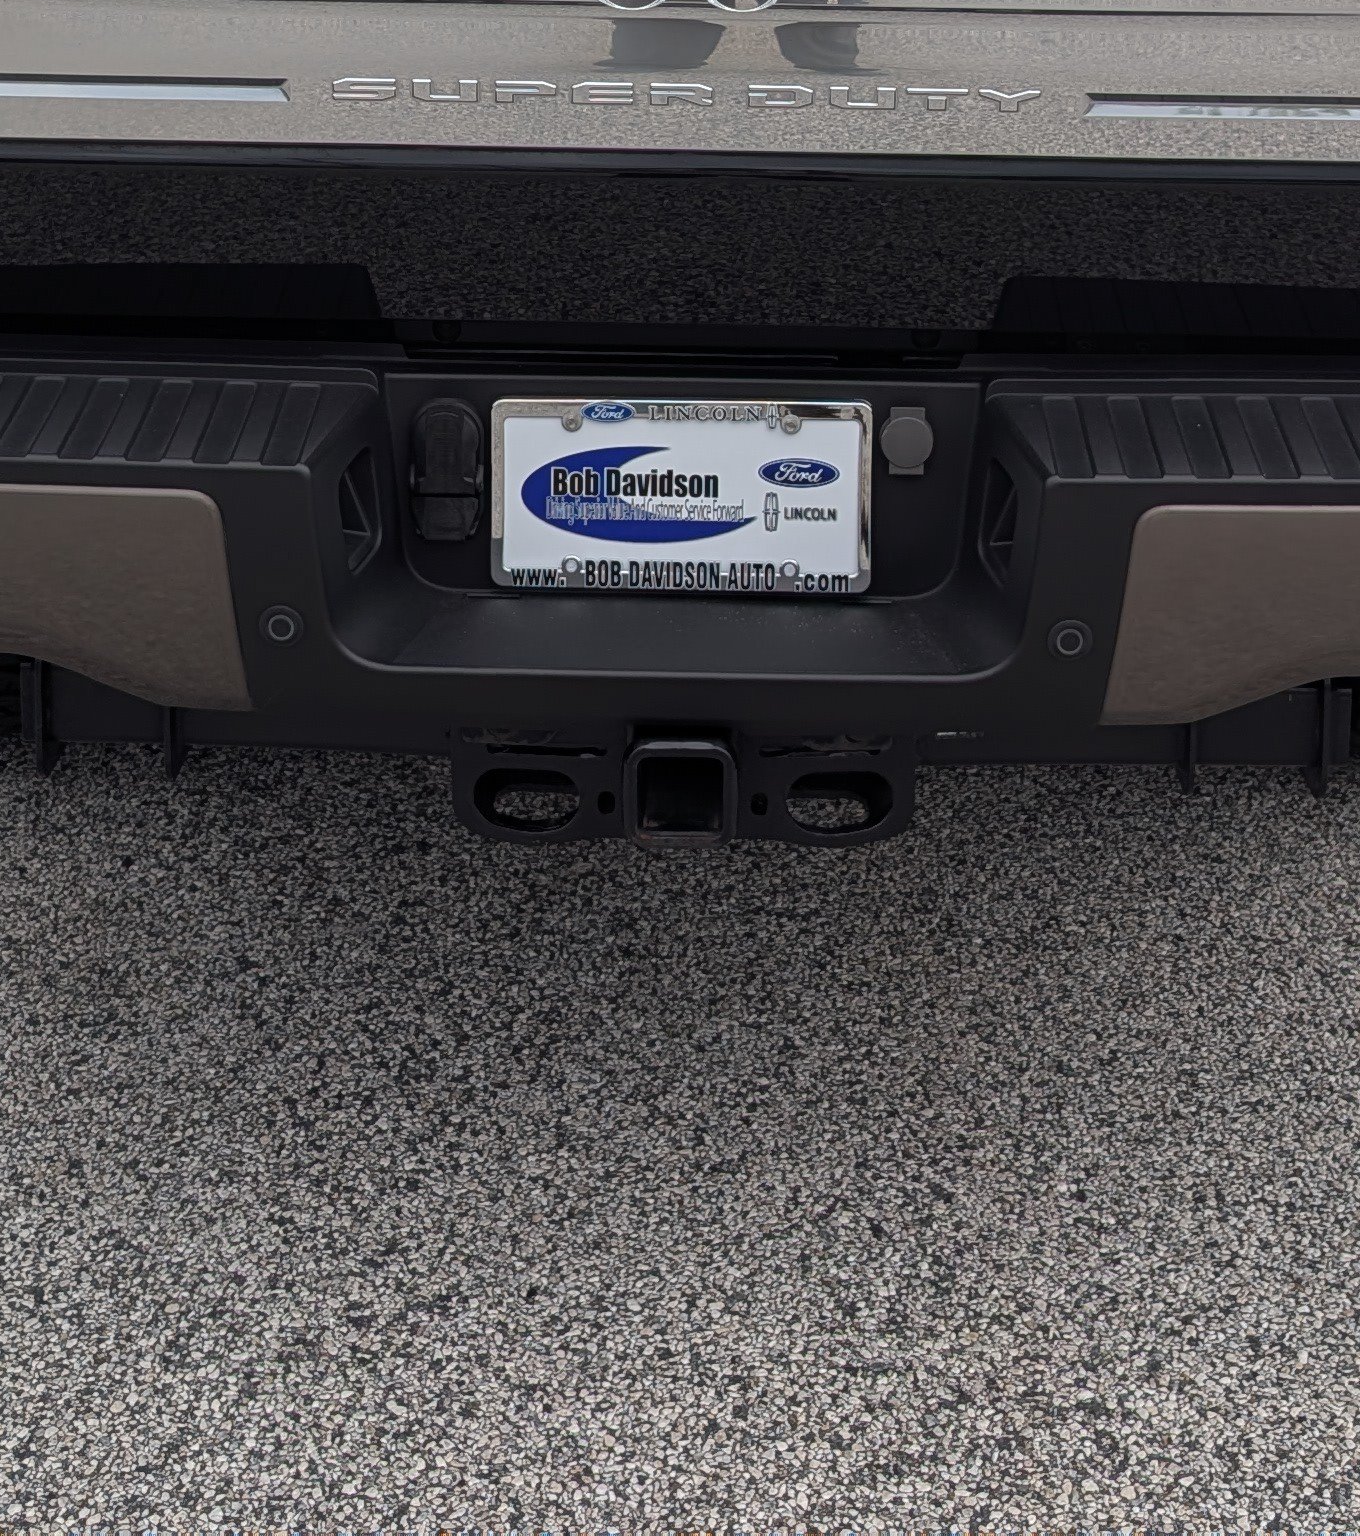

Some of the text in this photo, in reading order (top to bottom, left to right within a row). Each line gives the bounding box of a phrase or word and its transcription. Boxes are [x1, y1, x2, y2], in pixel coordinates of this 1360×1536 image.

[331, 76, 1043, 114] SUPER DUTY
[590, 404, 763, 422] Ford LINCOLN
[551, 468, 720, 498] Bob Davidson
[774, 462, 824, 483] Ford
[646, 497, 683, 521] Customer
[684, 498, 711, 521] Service
[712, 498, 745, 523] Forward
[783, 506, 838, 522] LINCOLN
[511, 567, 567, 588] www.
[583, 559, 622, 589] BOB
[628, 560, 722, 591] DAVIDSON
[726, 561, 777, 592] AUTO
